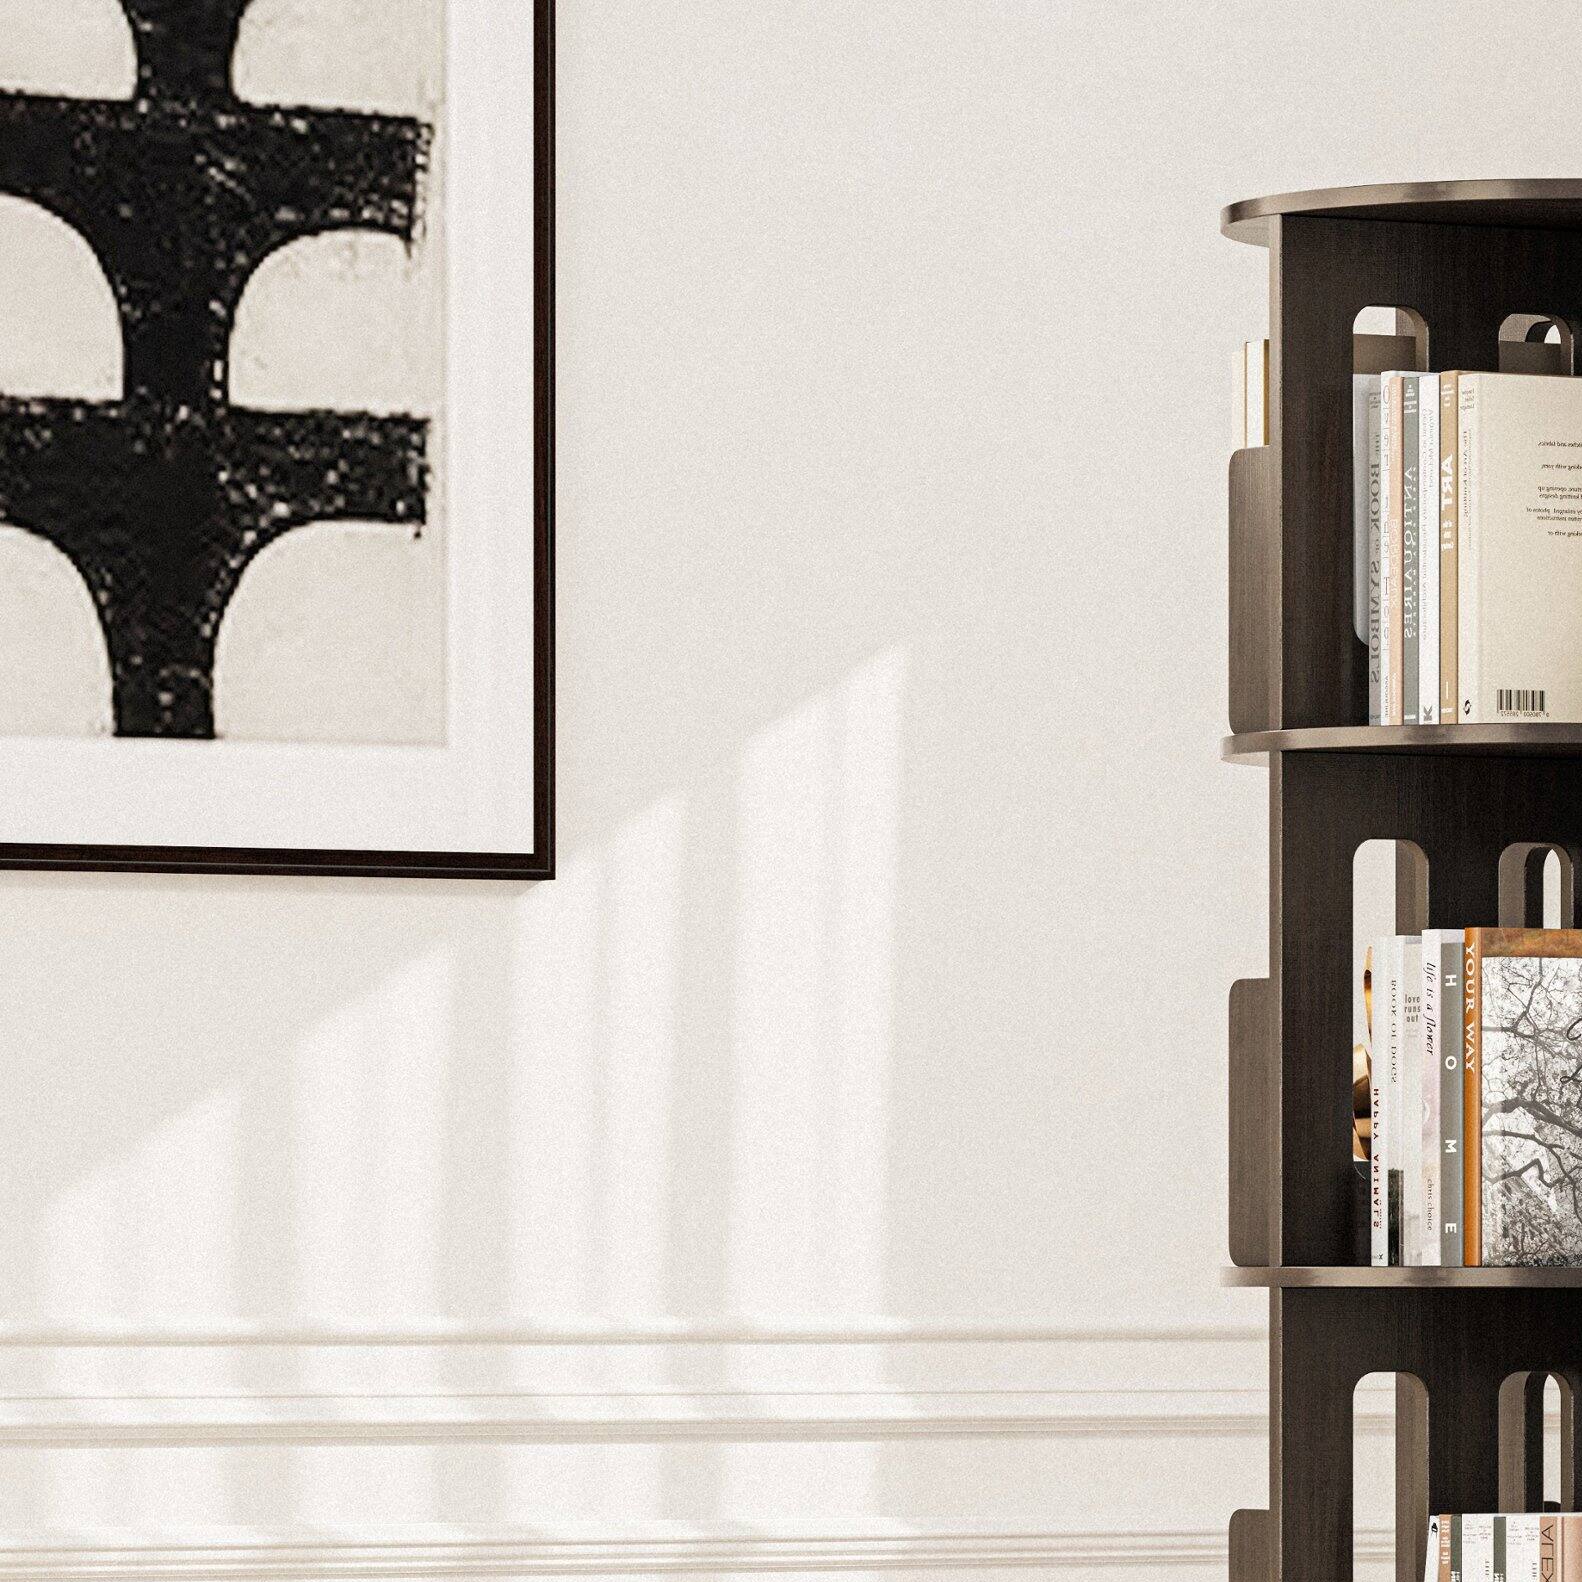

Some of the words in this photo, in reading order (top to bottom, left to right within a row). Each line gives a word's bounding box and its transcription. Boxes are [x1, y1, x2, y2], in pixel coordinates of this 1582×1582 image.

[1423, 962, 1436, 983] life
[1465, 942, 1475, 1014] YOUR
[1426, 988, 1436, 999] is
[1426, 1003, 1434, 1011] a
[1422, 1013, 1437, 1056] flower
[1465, 1021, 1475, 1074] WAY
[1427, 1179, 1435, 1200] chris
